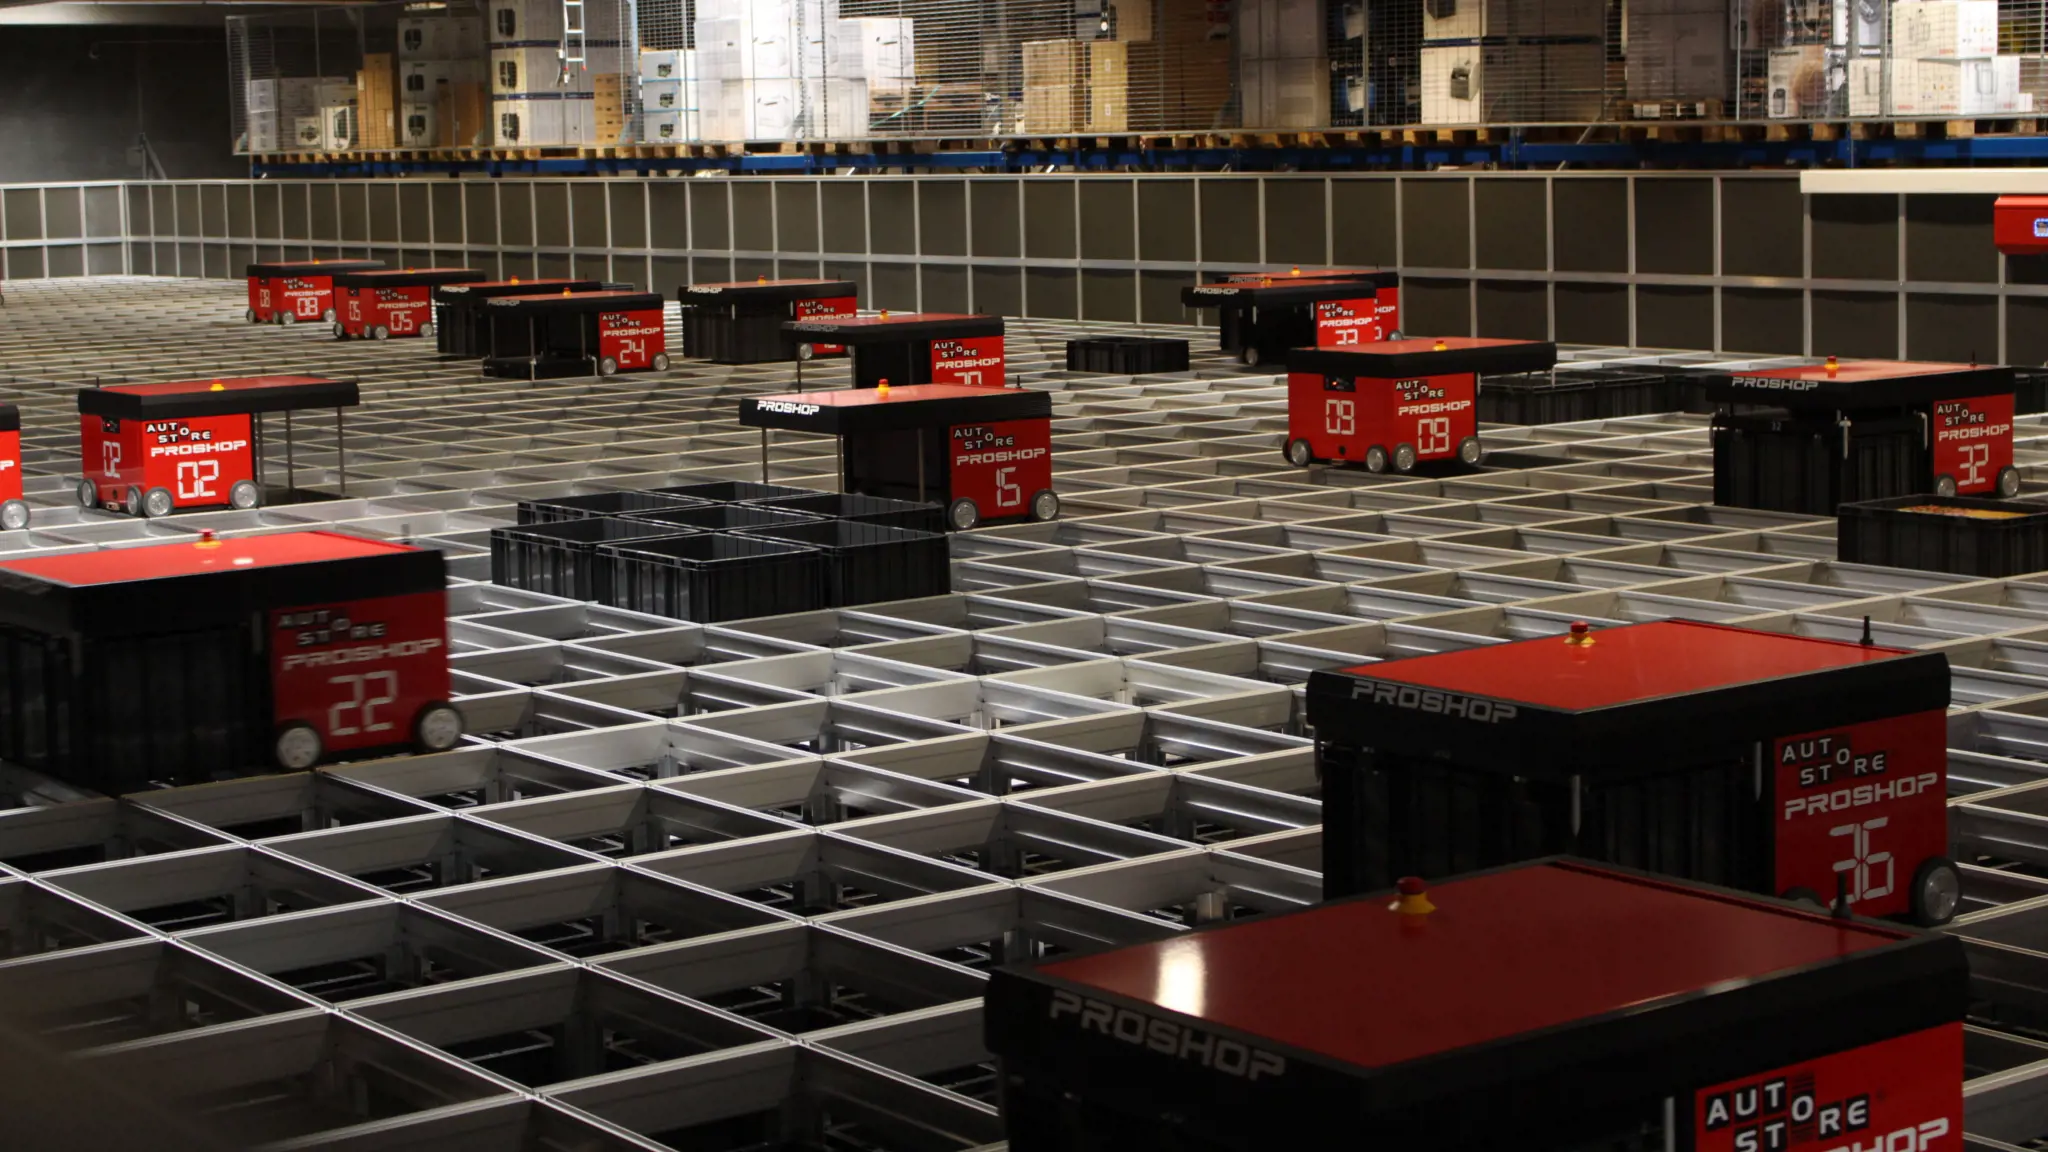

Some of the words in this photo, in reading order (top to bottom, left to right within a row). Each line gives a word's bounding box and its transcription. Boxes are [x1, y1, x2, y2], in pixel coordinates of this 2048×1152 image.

[687, 286, 722, 294] PROSHOP
[1193, 287, 1240, 296] PROSHOP
[297, 296, 318, 316] 08
[390, 310, 414, 332] 05
[603, 327, 661, 337] PROSHOP
[1319, 316, 1373, 328] PROSHOP
[620, 338, 645, 364] 24
[935, 357, 1001, 370] PROSHOP
[1732, 376, 1819, 392] PROSHOP
[757, 400, 820, 416] PROSHOP
[1326, 399, 1355, 435] 09
[1398, 400, 1471, 416] PROSHOP
[1418, 417, 1450, 455] 09
[1938, 424, 2011, 443] PROSHOP
[103, 440, 122, 479] 02
[151, 440, 247, 457] PROSHOP
[956, 448, 1046, 466] PROSHOP
[1957, 443, 1989, 487] 32
[177, 460, 219, 499] 02
[281, 638, 443, 671] PROSHOP
[327, 670, 398, 737] 22
[1351, 679, 1517, 724] PROSHOP
[1784, 772, 1938, 821] PROSHOP
[1829, 816, 1895, 910] 36
[1050, 989, 1286, 1081] PROSHOP
